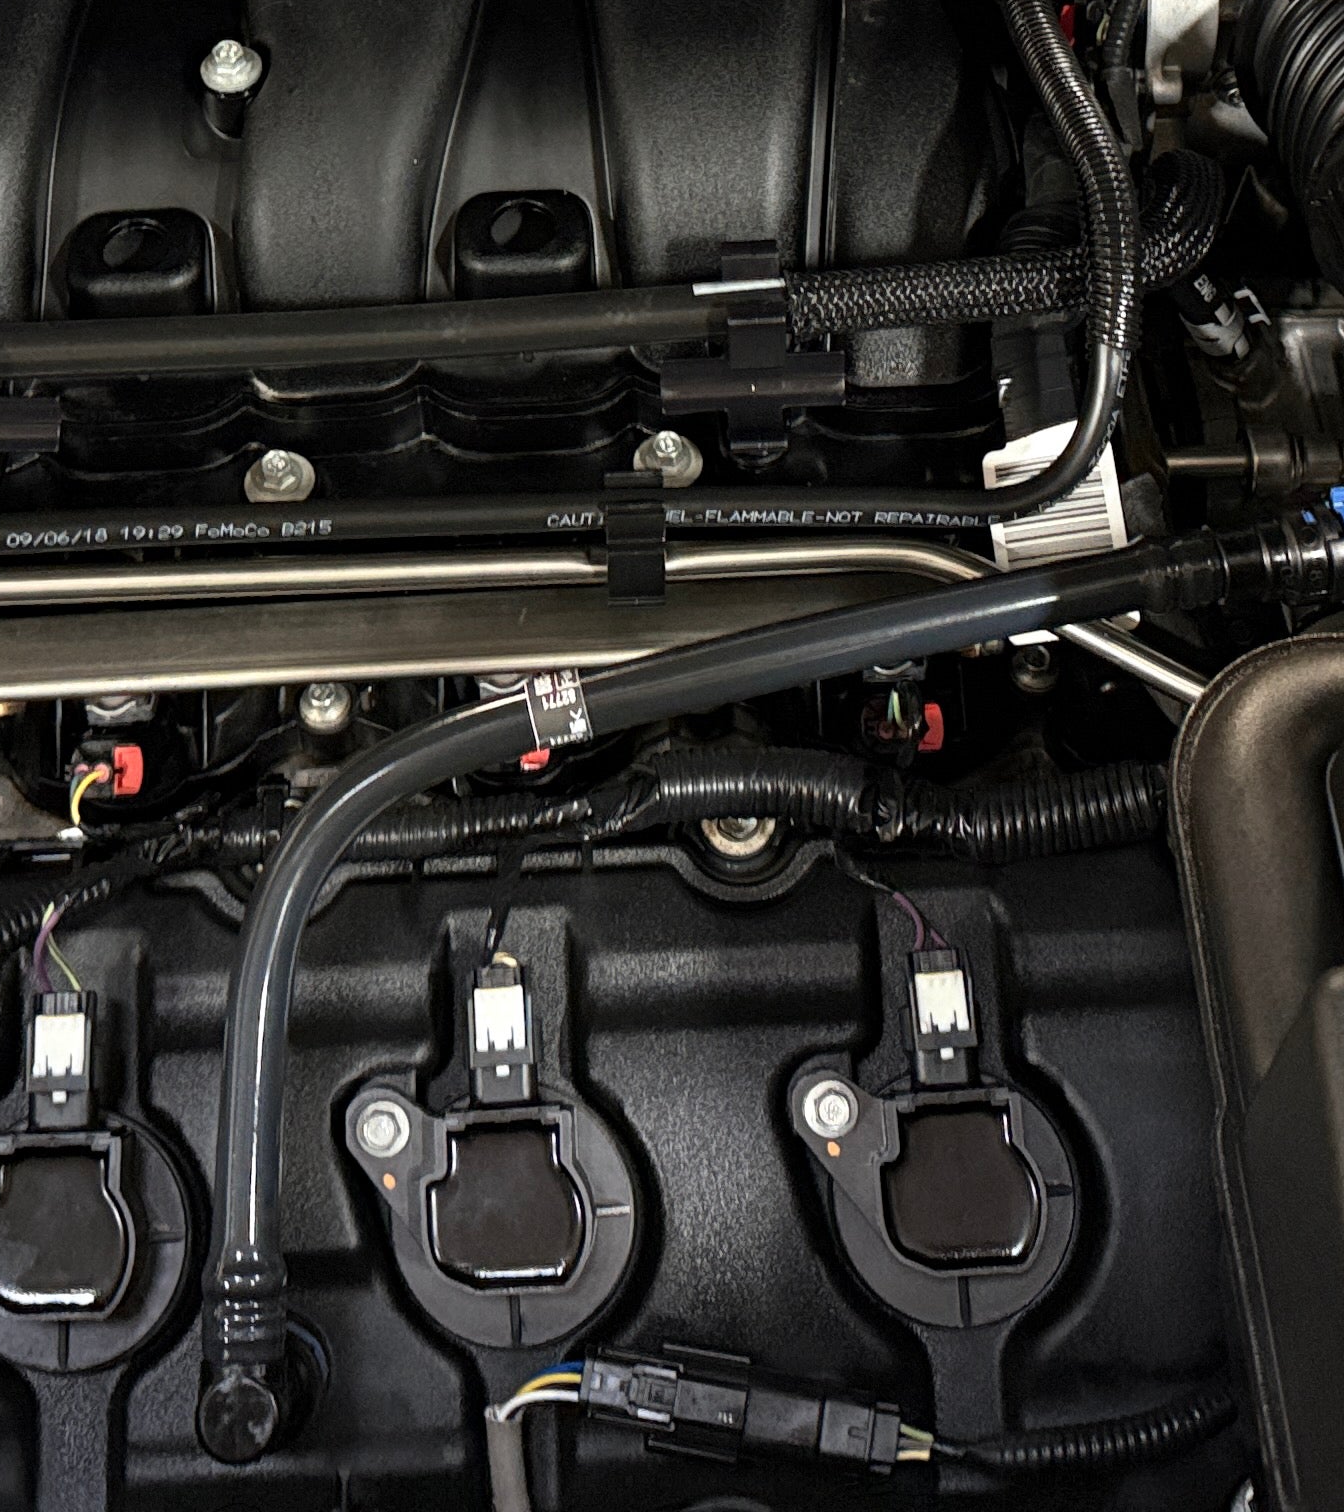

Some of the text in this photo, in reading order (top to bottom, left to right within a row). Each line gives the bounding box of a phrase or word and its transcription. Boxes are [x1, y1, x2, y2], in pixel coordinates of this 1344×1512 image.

[1194, 275, 1215, 301] ENG
[873, 510, 1000, 528] REPAIRABLE
[5, 527, 108, 550] 09/06/18
[195, 521, 270, 539] FoMoCo
